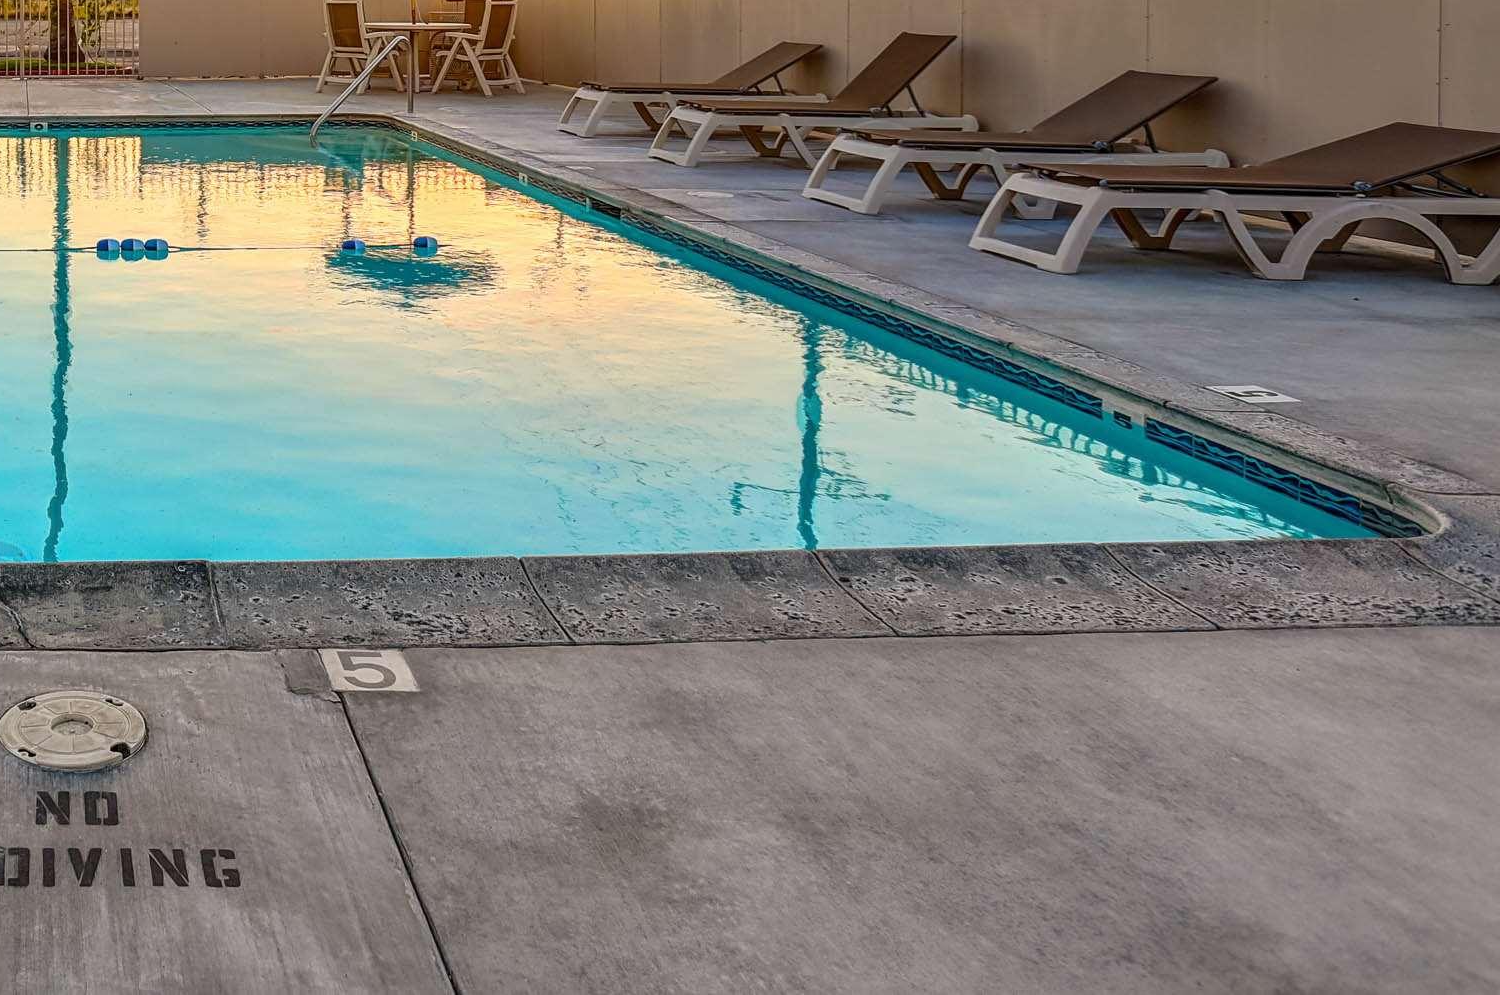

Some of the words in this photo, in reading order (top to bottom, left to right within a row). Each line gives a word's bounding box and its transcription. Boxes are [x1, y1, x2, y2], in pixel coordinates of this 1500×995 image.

[1113, 410, 1133, 429] 5
[337, 652, 397, 688] 5
[35, 791, 119, 826] NO
